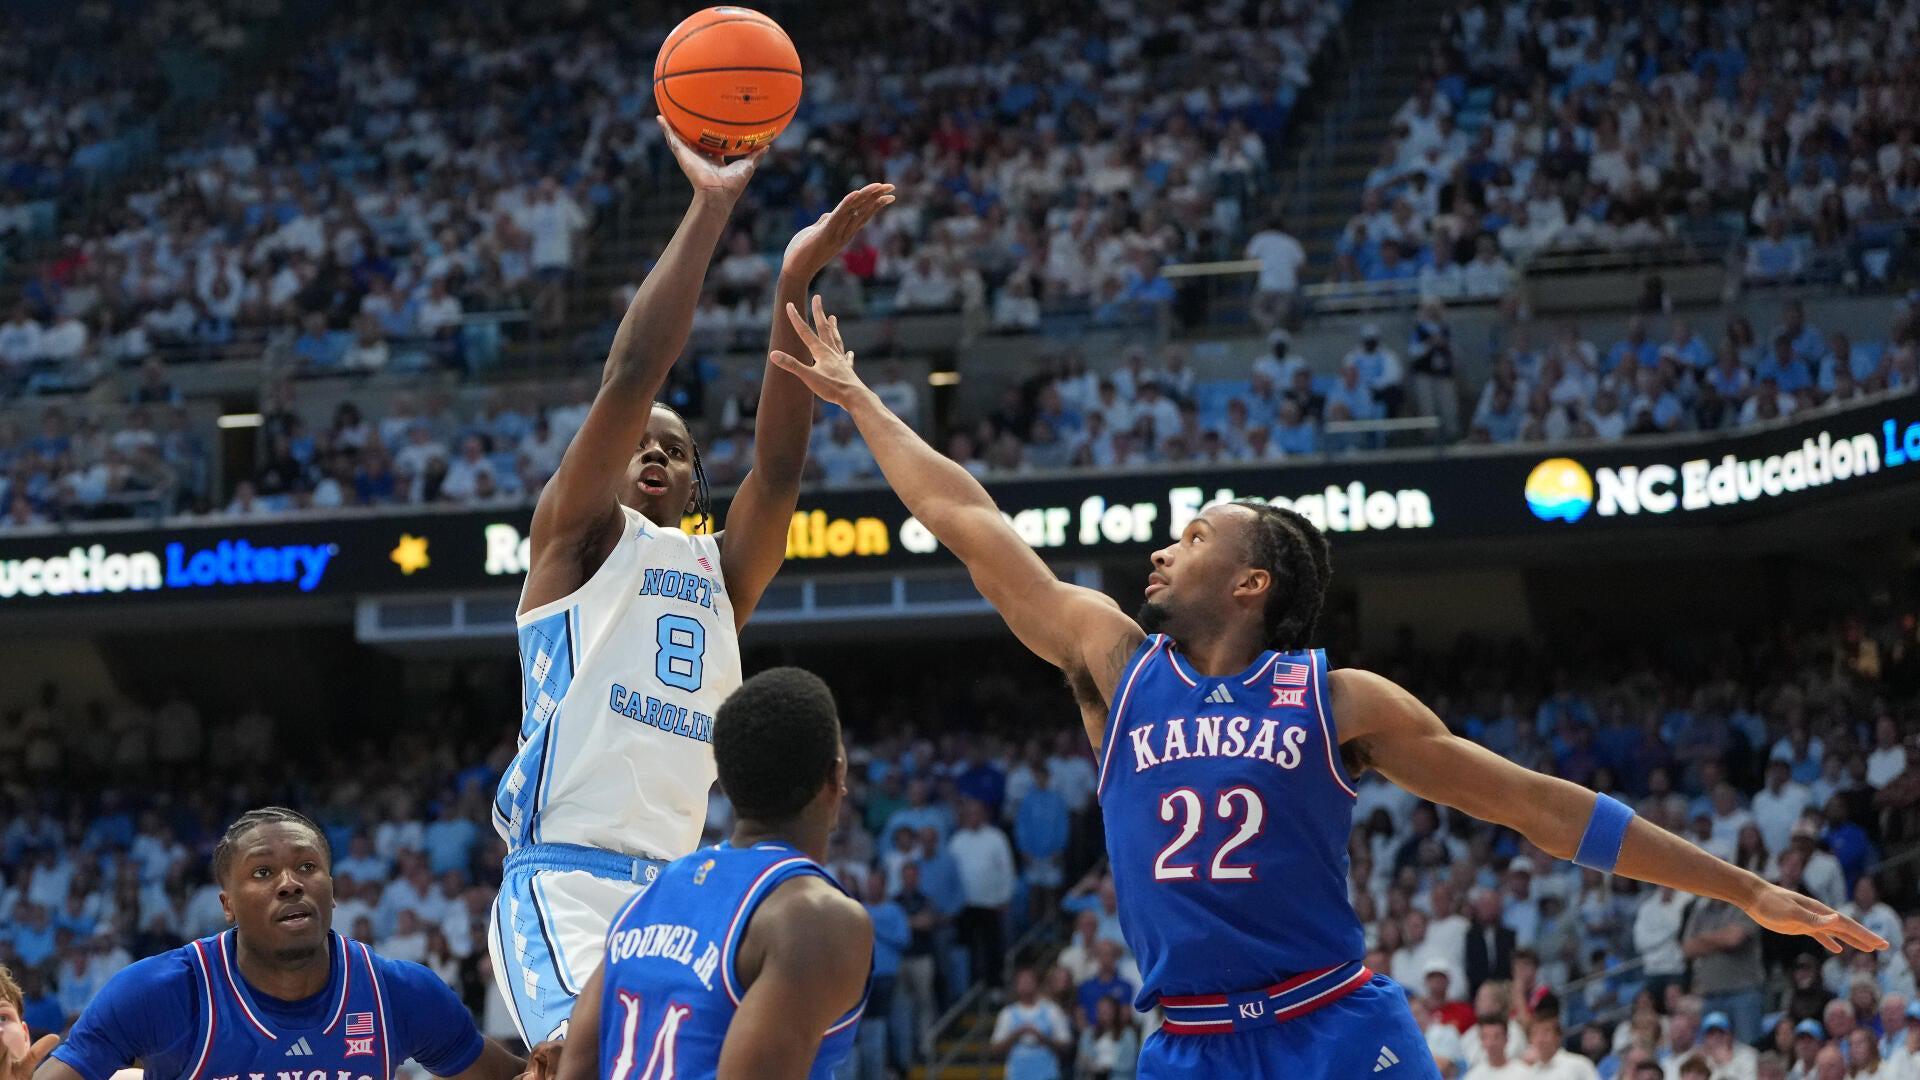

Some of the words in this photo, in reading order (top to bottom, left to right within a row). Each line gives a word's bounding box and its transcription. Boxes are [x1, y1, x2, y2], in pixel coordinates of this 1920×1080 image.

[1596, 464, 1679, 517] NC
[1681, 430, 1880, 511] Education
[1079, 495, 1157, 545] for
[1168, 480, 1433, 540] Eation
[165, 539, 331, 592] Lottery
[639, 568, 713, 608] NORT
[655, 613, 705, 694] 8
[1128, 715, 1308, 773] KANSAS
[1153, 787, 1264, 881] 22
[610, 923, 698, 964] COUNCIL
[1238, 1000, 1265, 1019] KU
